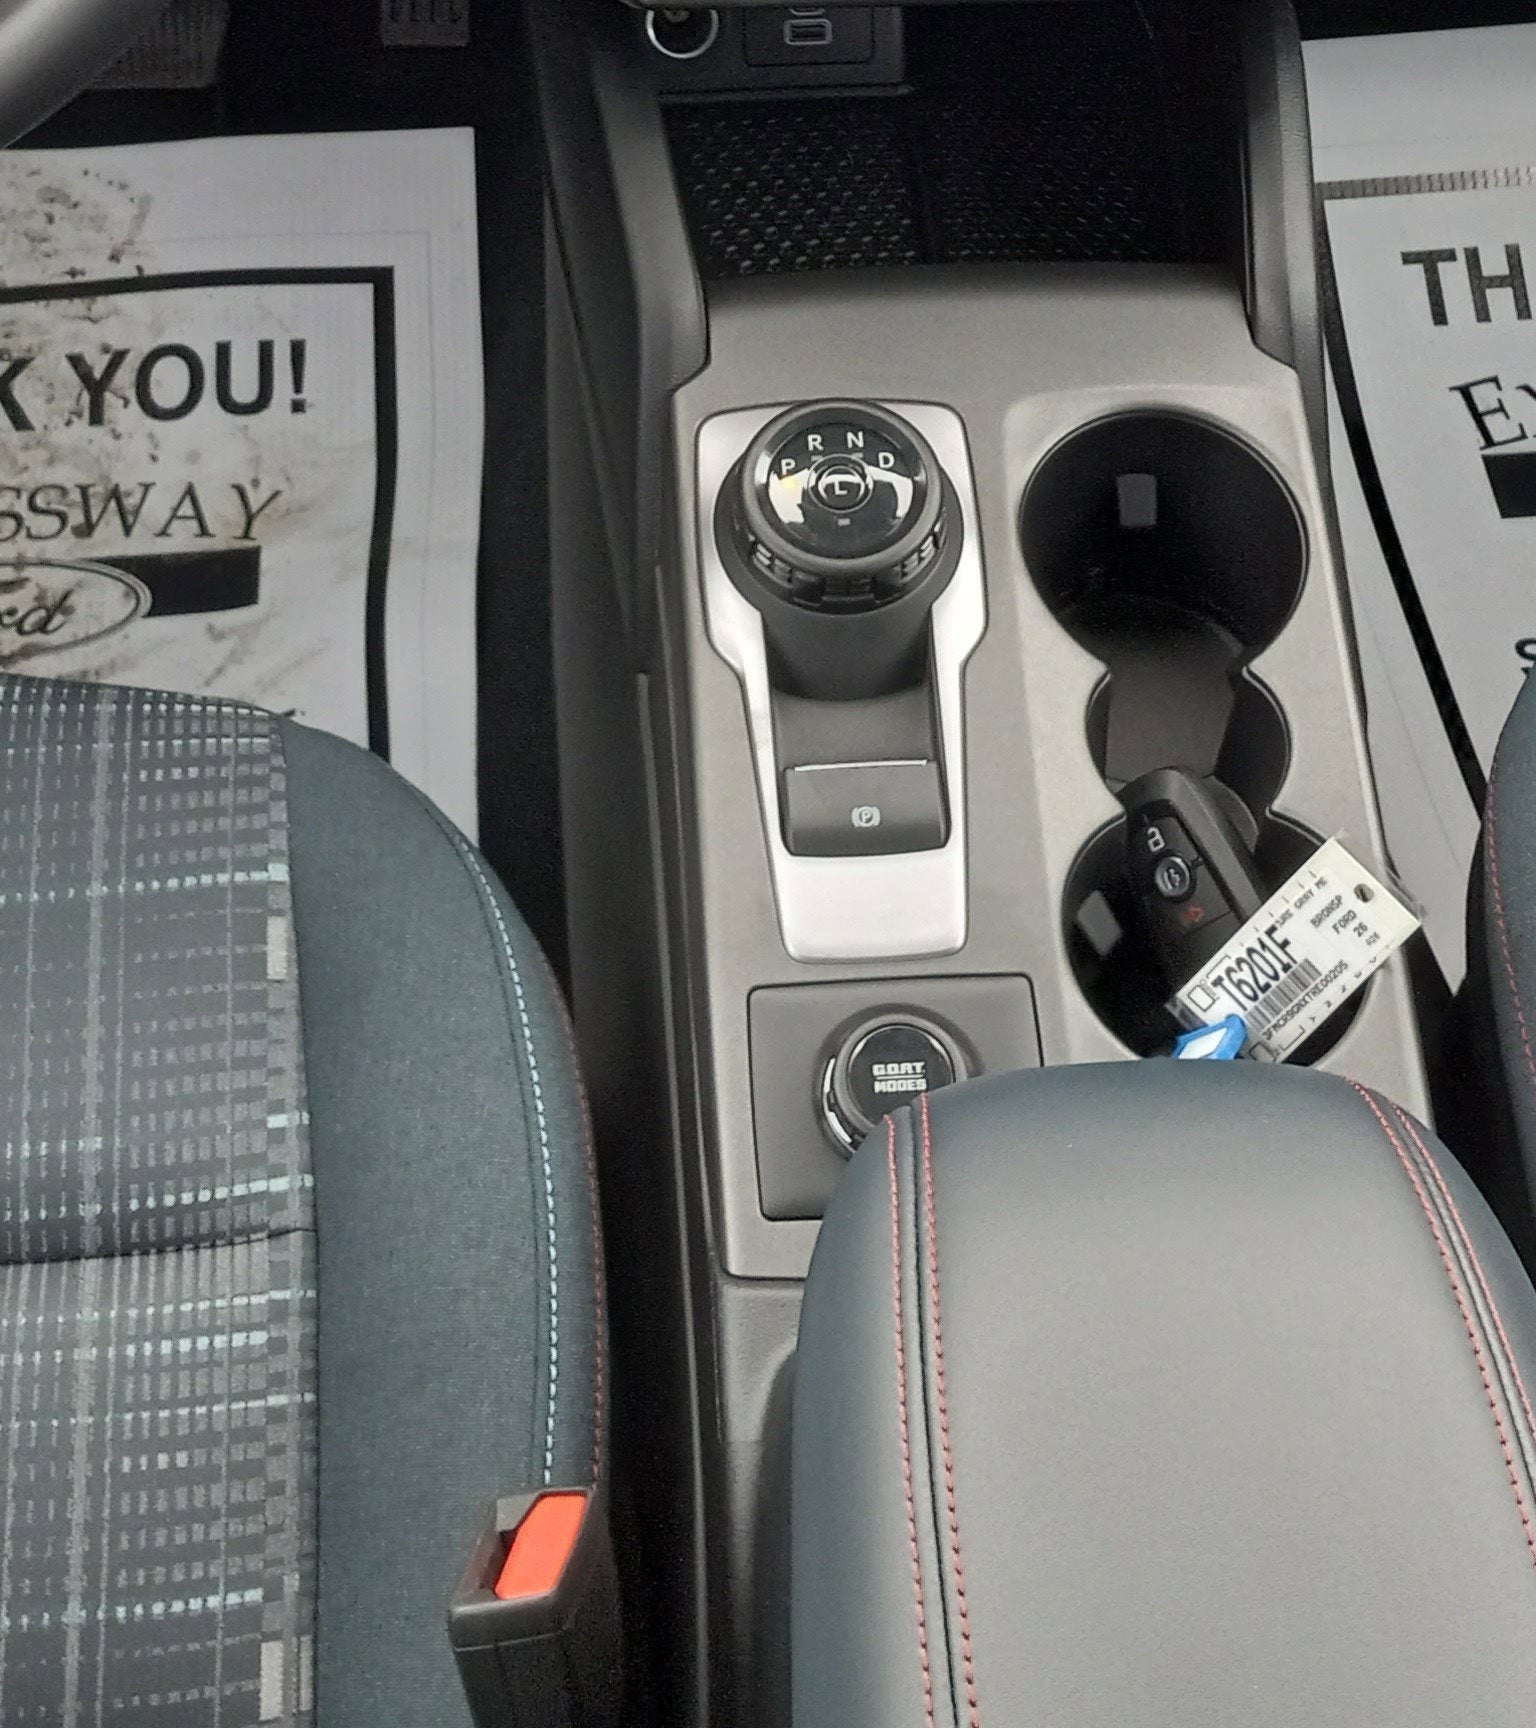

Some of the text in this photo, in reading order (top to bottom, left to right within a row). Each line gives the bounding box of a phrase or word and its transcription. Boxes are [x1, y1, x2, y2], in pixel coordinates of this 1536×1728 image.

[65, 338, 309, 426] YOU!
[780, 431, 895, 476] P R N D
[834, 478, 849, 496] L
[1332, 909, 1358, 935] FORD
[1211, 924, 1299, 1012] T6201F
[874, 1078, 927, 1094] MODES
